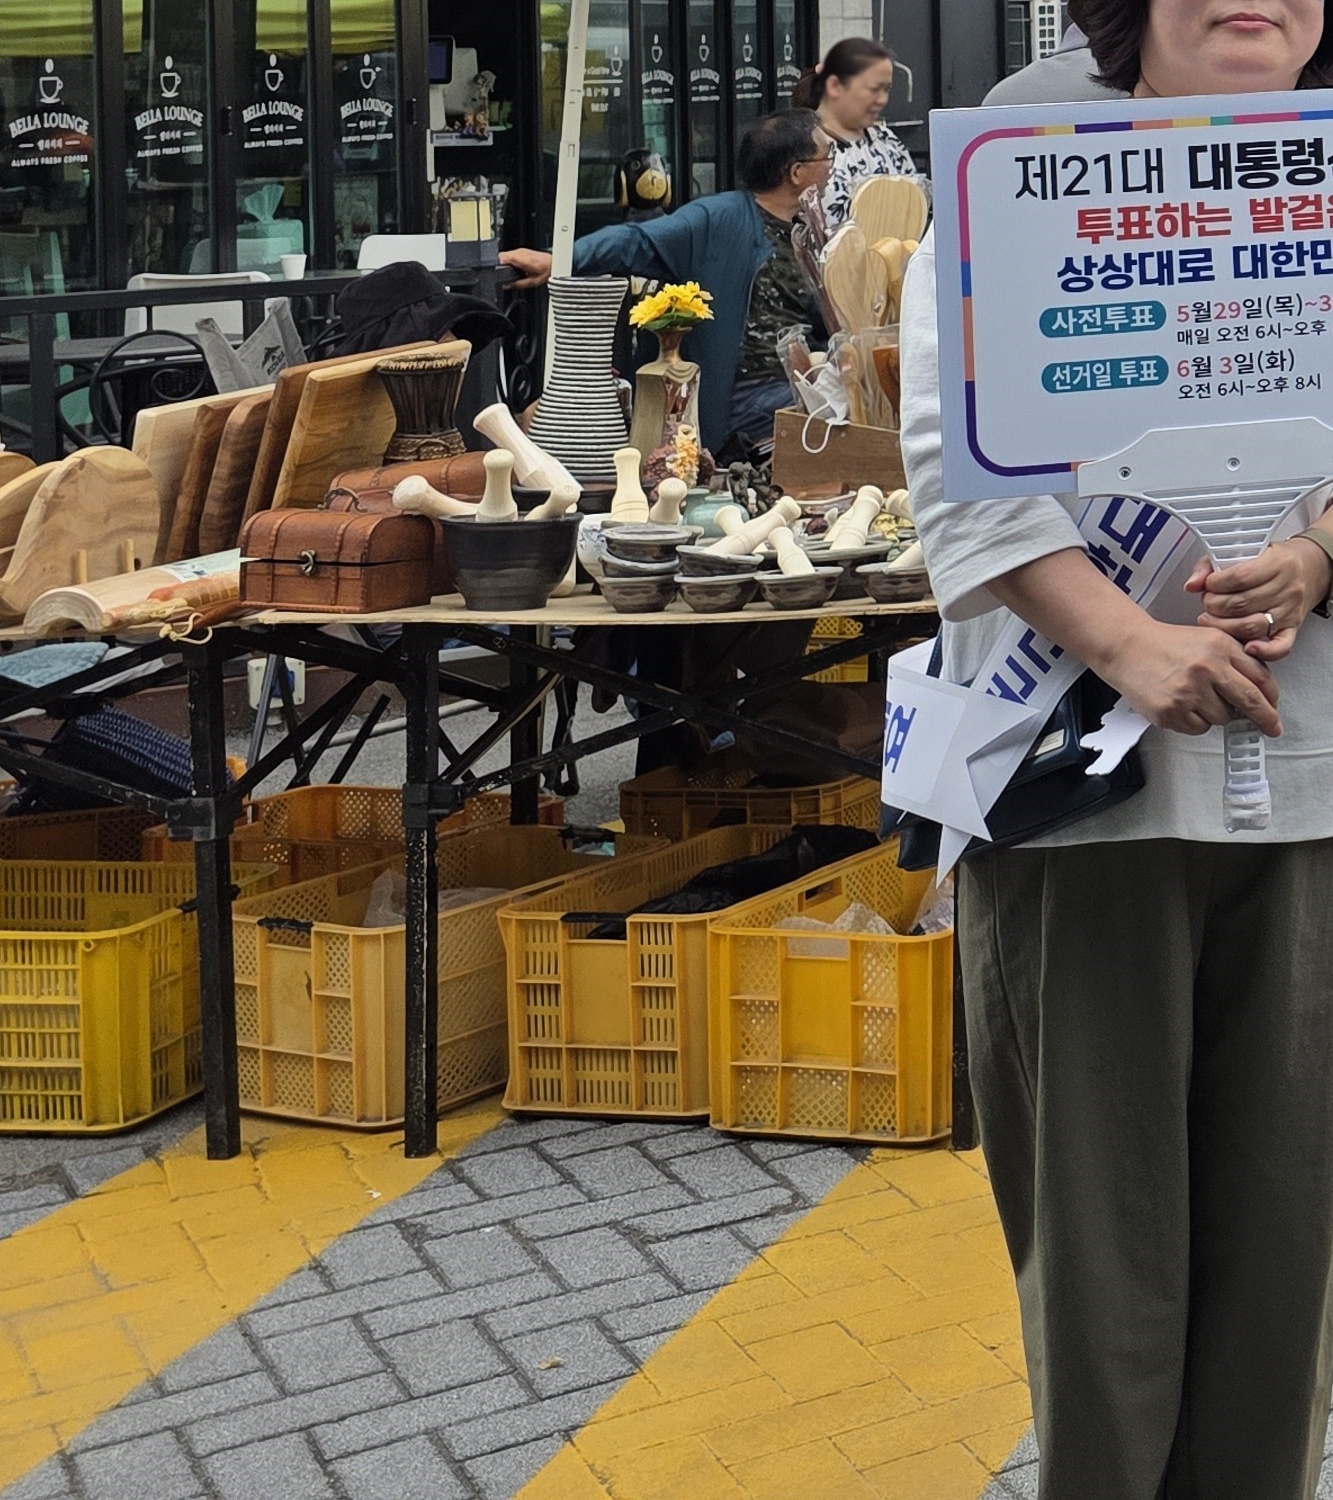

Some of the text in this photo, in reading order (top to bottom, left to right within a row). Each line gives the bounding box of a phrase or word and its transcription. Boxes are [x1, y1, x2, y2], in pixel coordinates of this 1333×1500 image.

[9, 111, 89, 138] BELLA LOUNGE
[135, 106, 203, 130] BELLA LOUNGE
[242, 100, 304, 123] BELLA LOUNGE
[1015, 147, 1164, 201] 제21대
[1076, 201, 1232, 244] 투표하는
[1057, 247, 1215, 293] 상상대로
[1051, 306, 1156, 334] 사전투표
[1177, 328, 1211, 347] 매일
[1217, 324, 1251, 343] 오전
[1256, 319, 1328, 343] 6시~오후
[1052, 358, 1160, 392] 선거일 투표
[1177, 347, 1295, 380] 6월 3일(화)
[1178, 372, 1322, 400] 오전 6시~오후 8시
